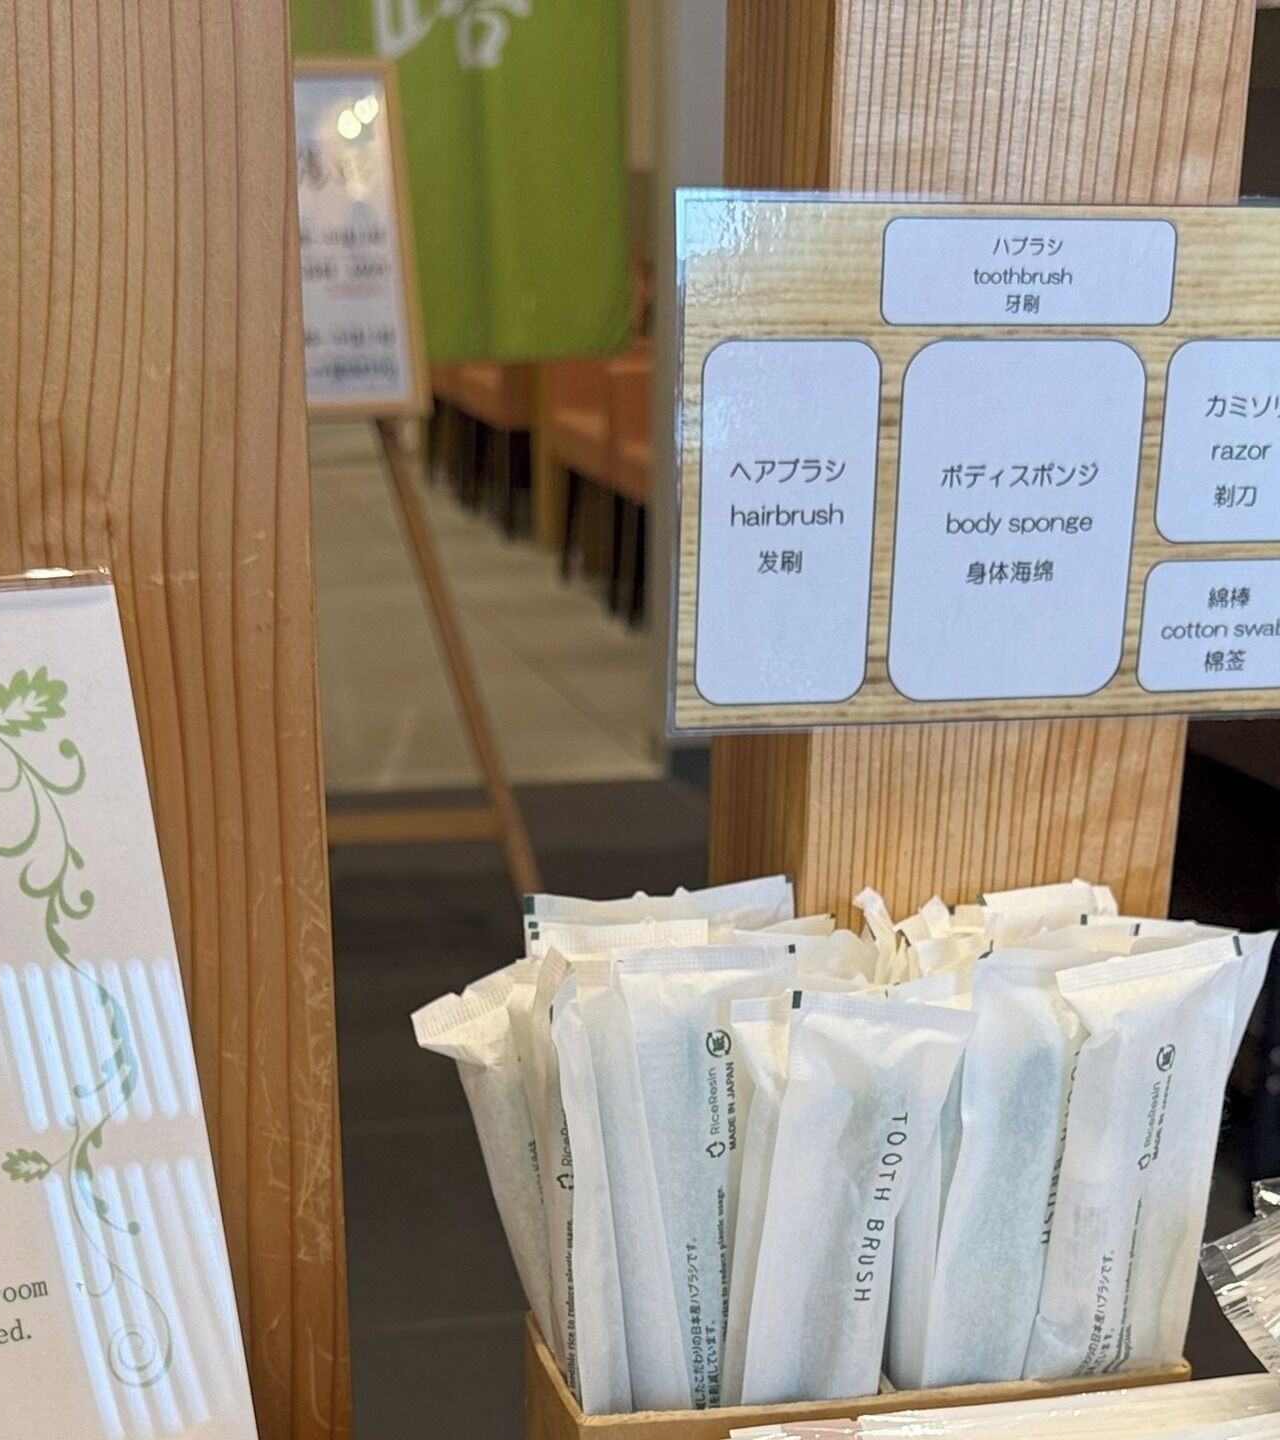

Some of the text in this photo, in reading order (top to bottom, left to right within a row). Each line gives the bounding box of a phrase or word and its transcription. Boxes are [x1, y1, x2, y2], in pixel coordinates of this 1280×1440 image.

[973, 268, 1073, 285] toothbrush
[1005, 294, 1040, 313] 牙刷
[1211, 443, 1272, 461] razor
[729, 458, 847, 484] ヘアブラシ
[940, 462, 1099, 489] ボディスポンジ
[1213, 485, 1257, 508] 剃刀
[730, 504, 844, 527] hairbrush
[946, 512, 1093, 536] body sponge
[757, 550, 803, 575] 发刷
[966, 560, 1055, 585] 身体海绵
[1208, 587, 1250, 609] 綿棒
[1160, 621, 1228, 640] cotton
[1203, 649, 1246, 673] 棉签
[706, 1066, 721, 1135] RiceResin
[725, 1061, 737, 1151] MADE IN JAPAN
[853, 1111, 909, 1303] TOOTH BRUSH
